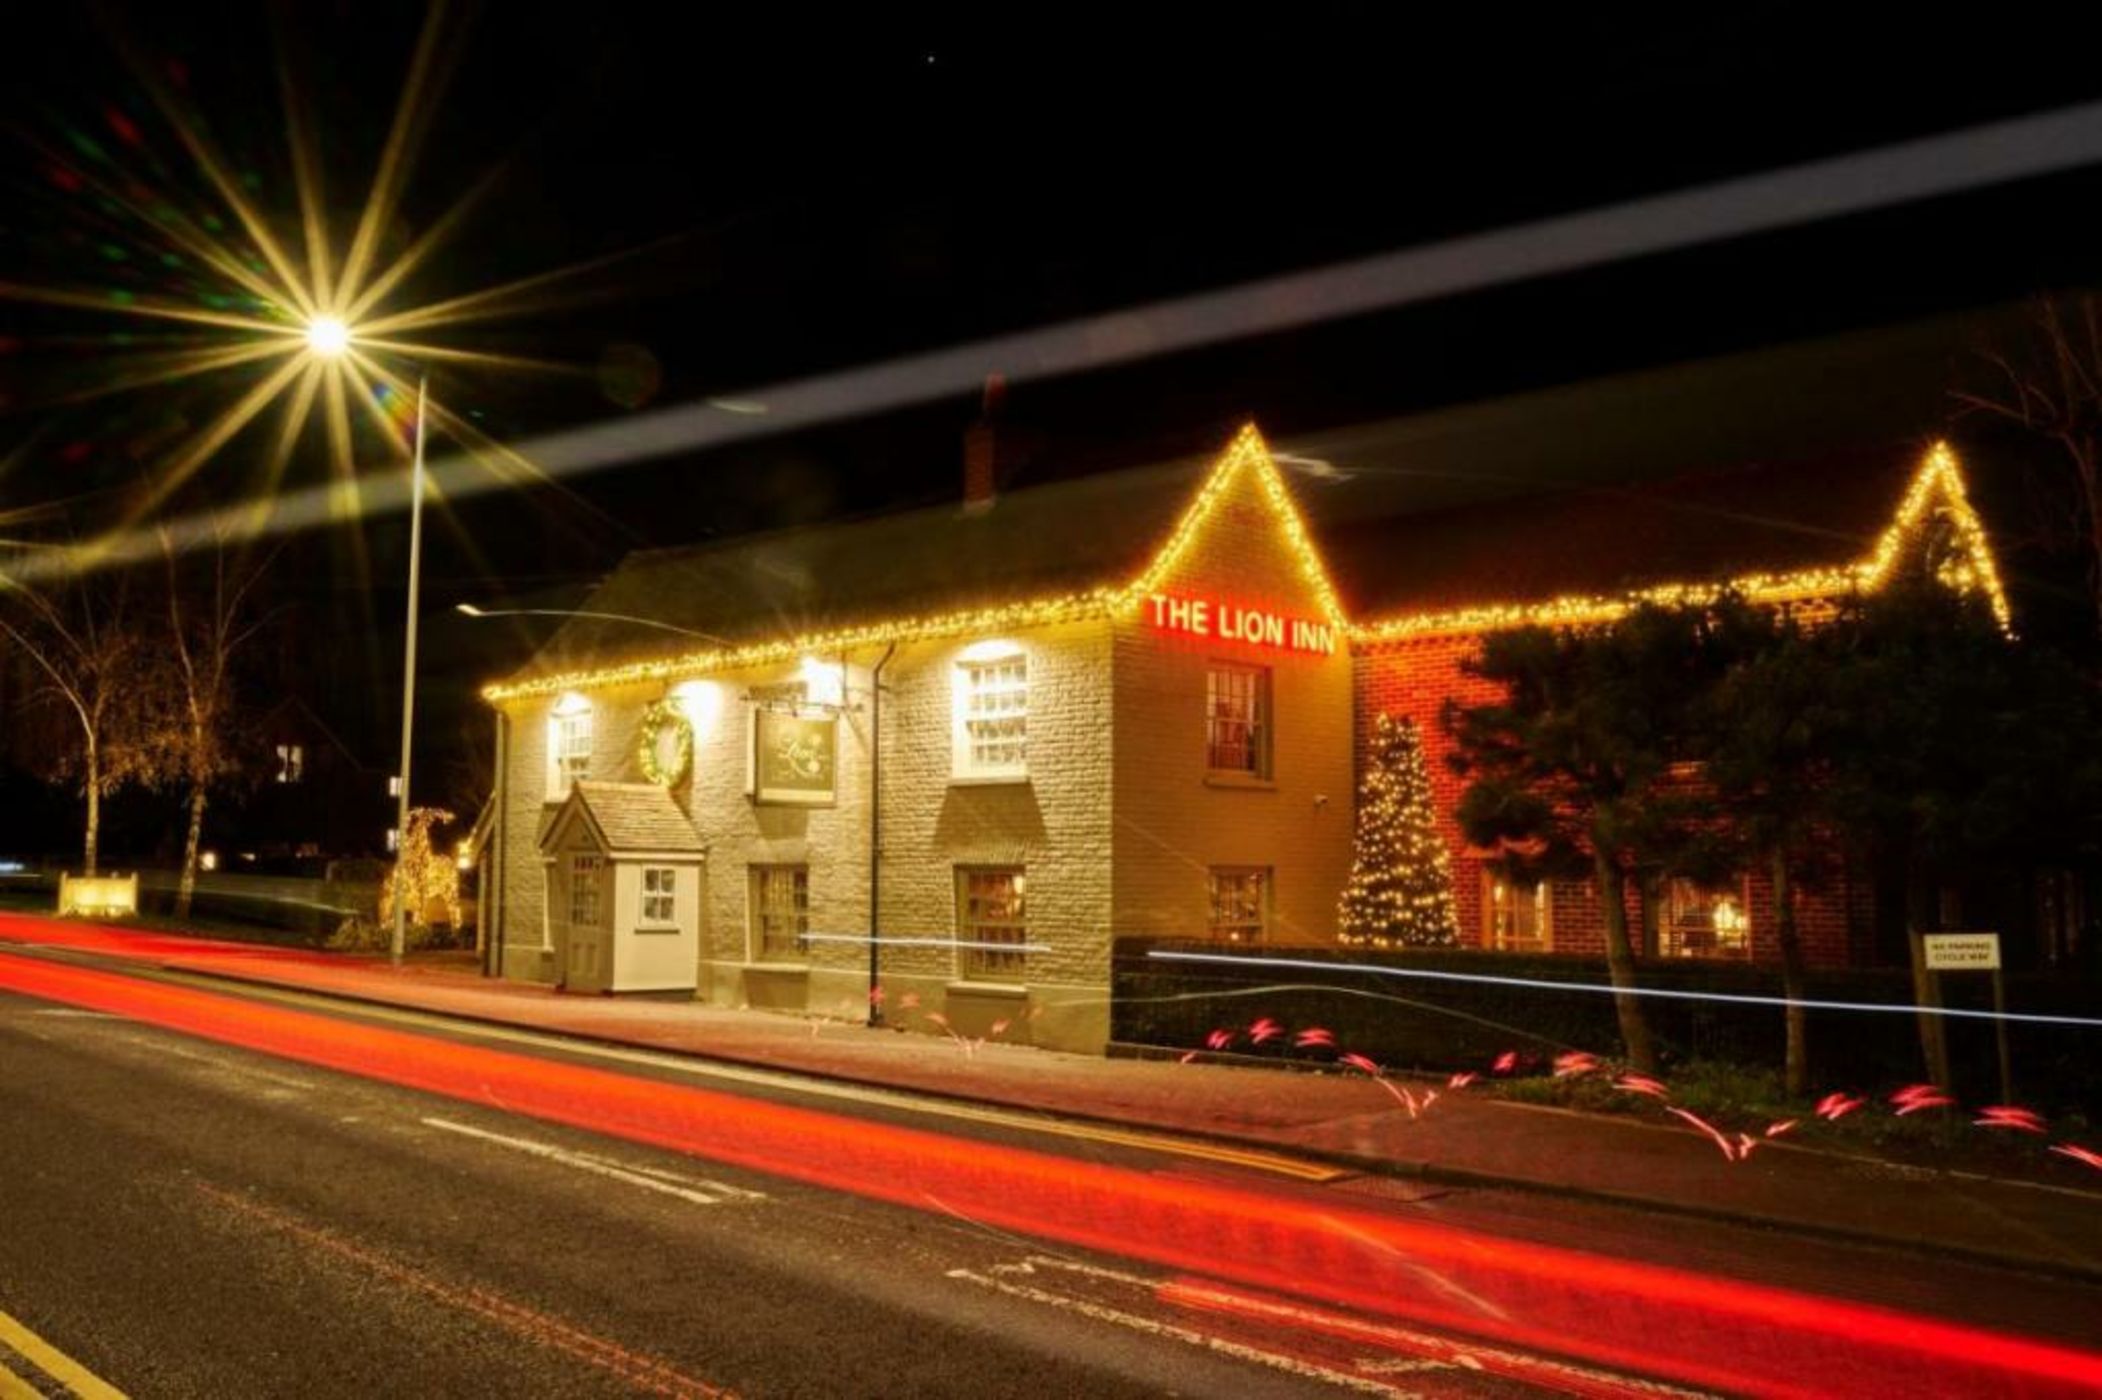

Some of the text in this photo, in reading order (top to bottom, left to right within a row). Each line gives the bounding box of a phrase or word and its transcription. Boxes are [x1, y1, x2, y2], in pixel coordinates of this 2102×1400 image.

[1151, 594, 1335, 654] THE LION INN
